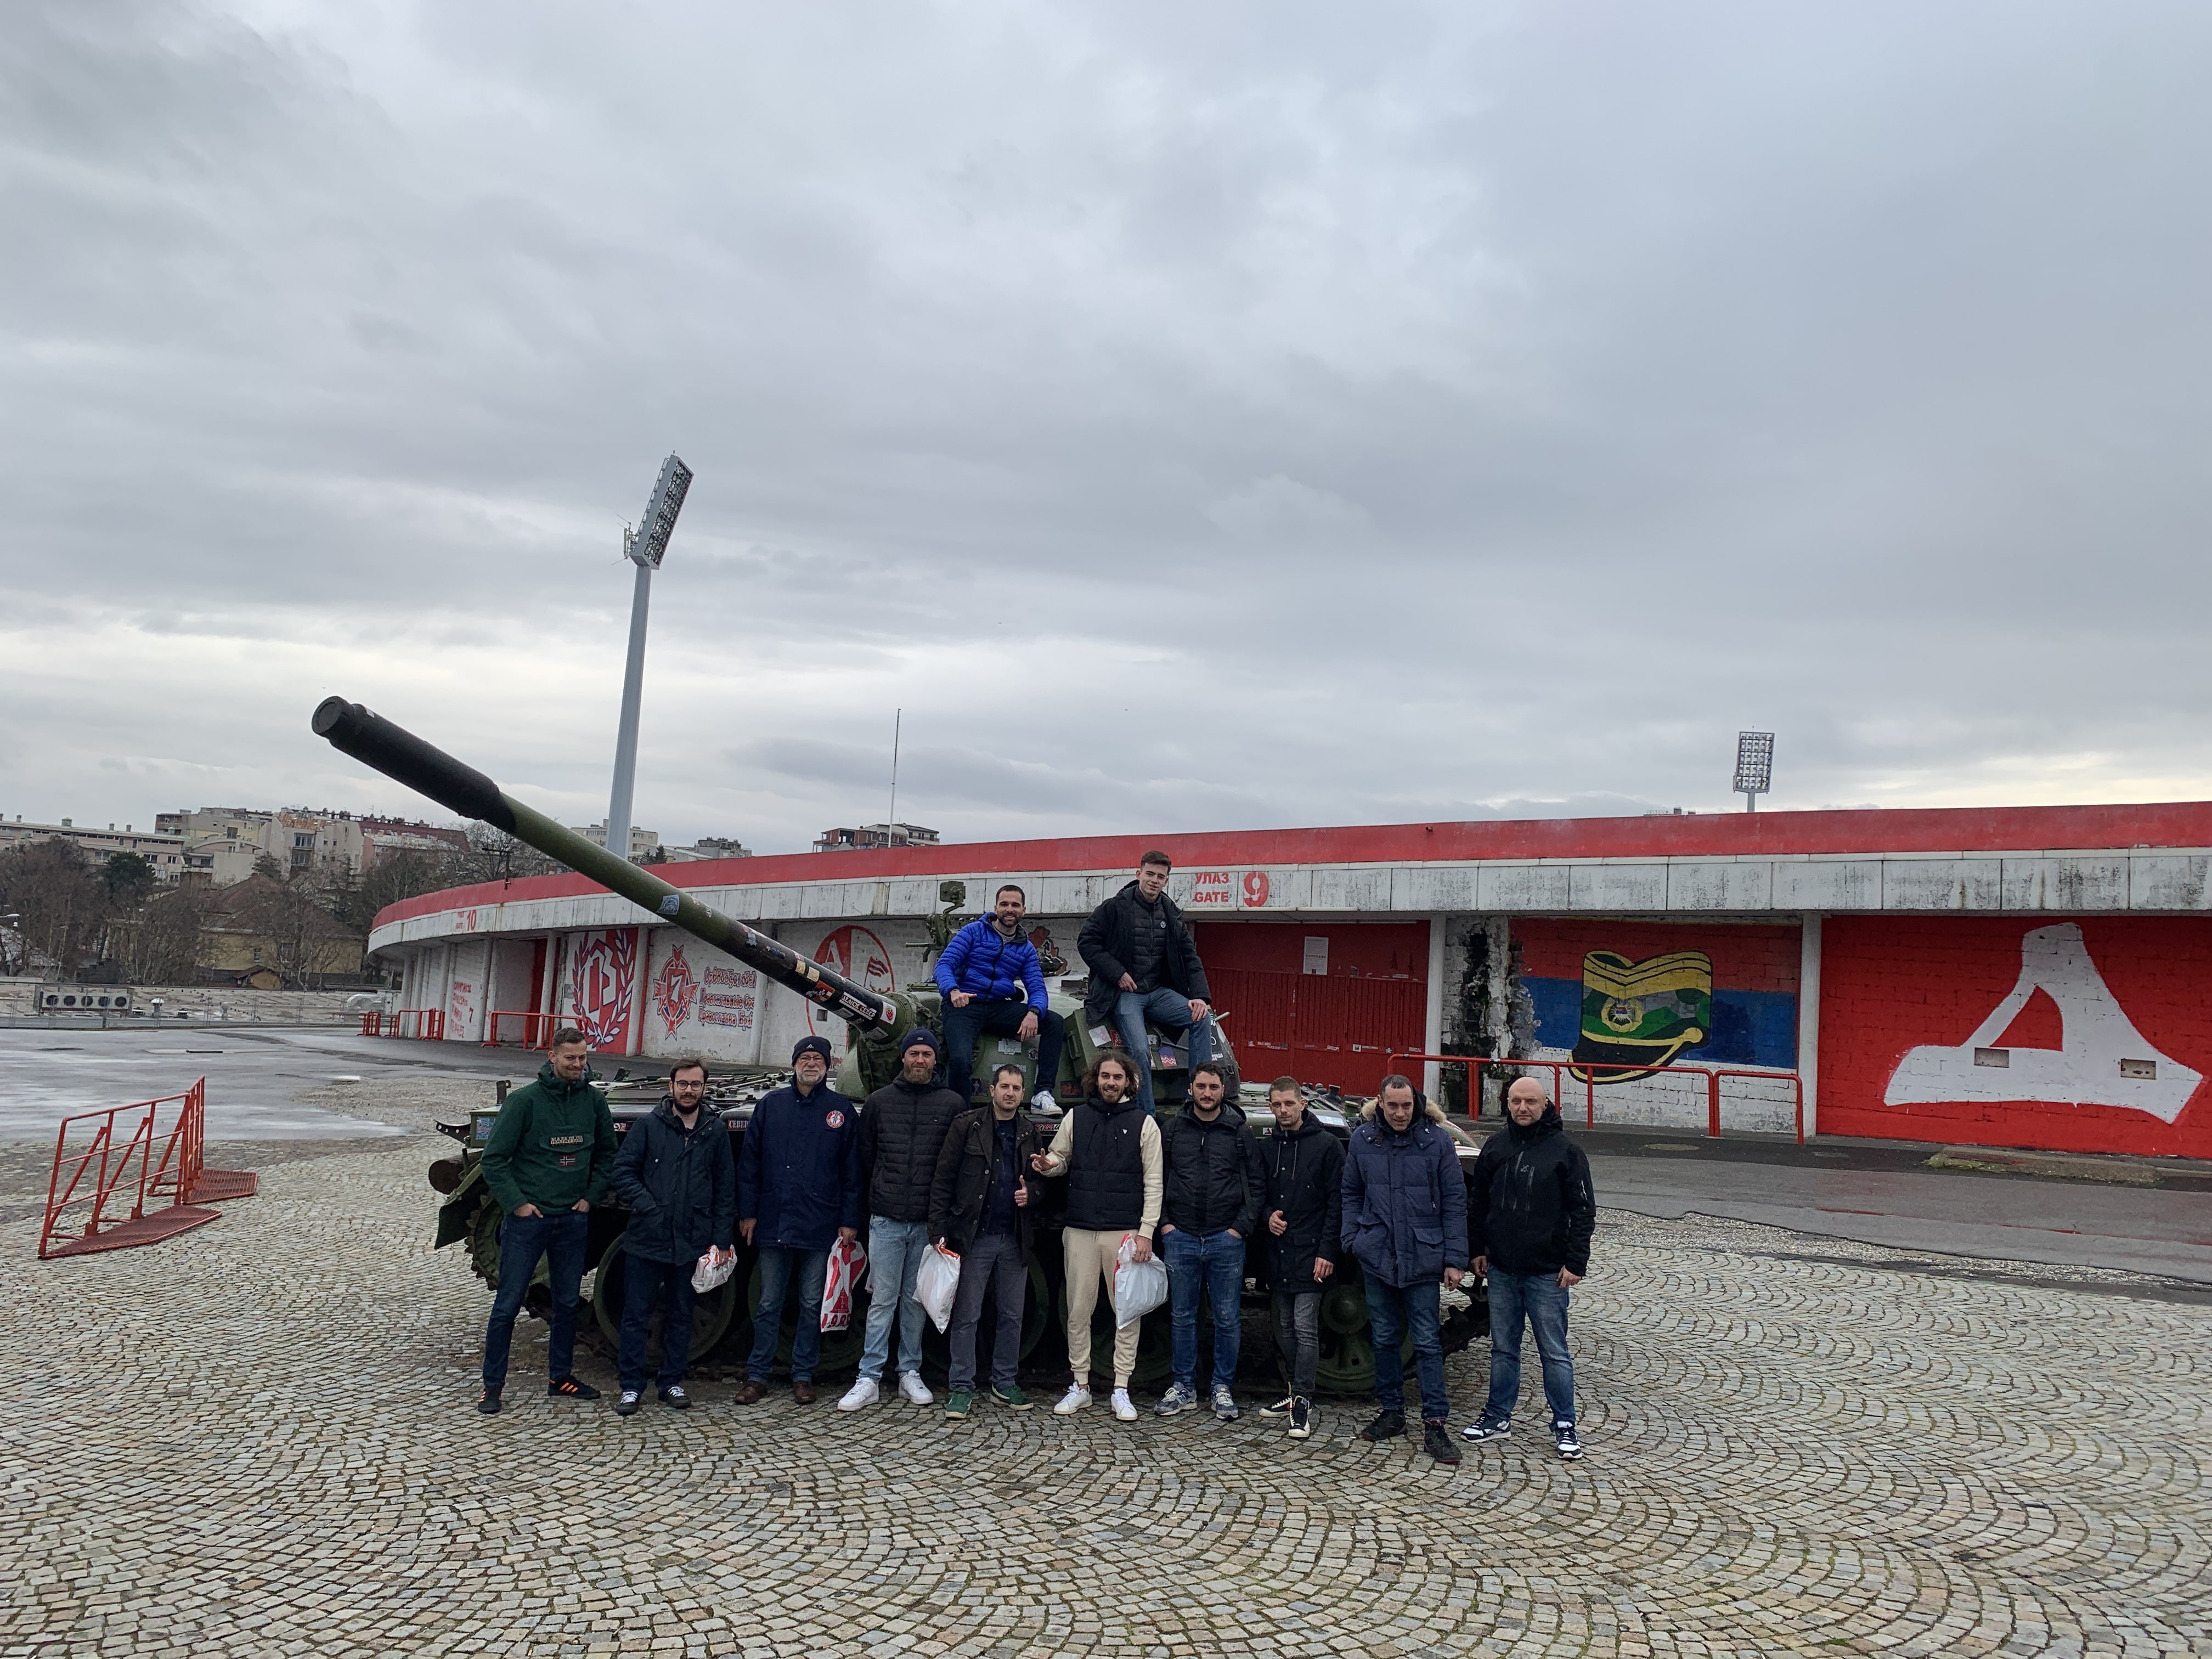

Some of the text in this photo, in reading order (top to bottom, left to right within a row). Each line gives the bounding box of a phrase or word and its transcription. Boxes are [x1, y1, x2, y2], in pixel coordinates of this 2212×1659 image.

[1194, 872, 1229, 884] УЛАЗ
[1194, 891, 1229, 902] GATE
[1243, 871, 1269, 907] 9
[466, 910, 477, 931] 10
